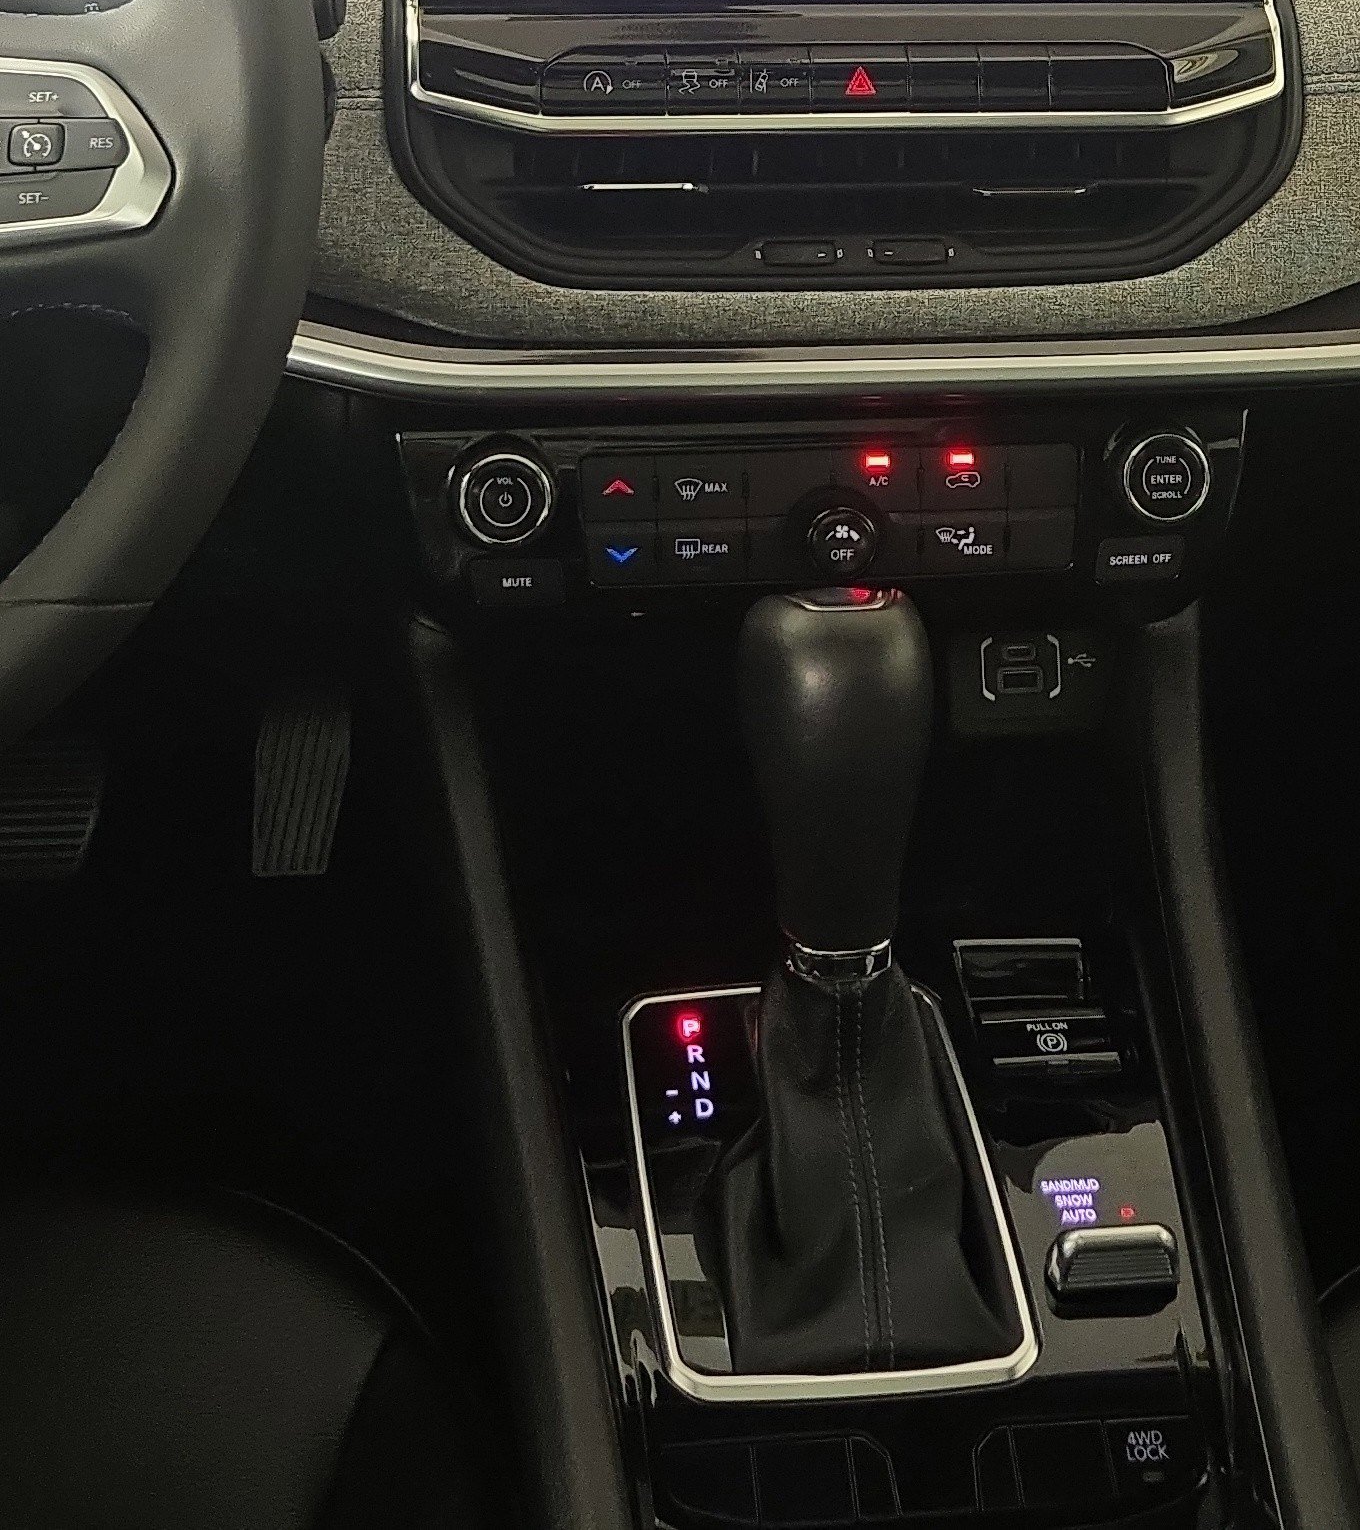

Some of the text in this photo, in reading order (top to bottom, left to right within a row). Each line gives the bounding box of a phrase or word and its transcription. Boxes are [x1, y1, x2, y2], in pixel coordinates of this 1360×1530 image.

[622, 79, 641, 89] OFF
[709, 78, 729, 89] OFF
[780, 77, 800, 88] OFF
[89, 137, 114, 149] RES
[1156, 455, 1177, 465] TUNE
[496, 476, 514, 486] VOL
[869, 476, 889, 487] A/C
[1150, 473, 1183, 486] ENTER
[705, 482, 729, 493] MAX
[1152, 490, 1183, 501] SCROLL
[701, 543, 729, 555] REAR
[830, 548, 855, 562] OFF
[963, 544, 993, 556] MODE
[1109, 552, 1172, 566] SCREEN OFF
[502, 577, 533, 589] MUTE
[682, 1019, 700, 1037] P
[1026, 1021, 1068, 1032] PULL ON
[686, 1044, 705, 1063] R
[690, 1070, 711, 1091] N
[694, 1098, 714, 1119] D
[1041, 1178, 1100, 1193] SAND/MUD
[1055, 1193, 1093, 1208] SNOW
[1062, 1209, 1097, 1224] AUTO
[1127, 1430, 1163, 1445] 4WD
[1126, 1444, 1170, 1461] LOCK
